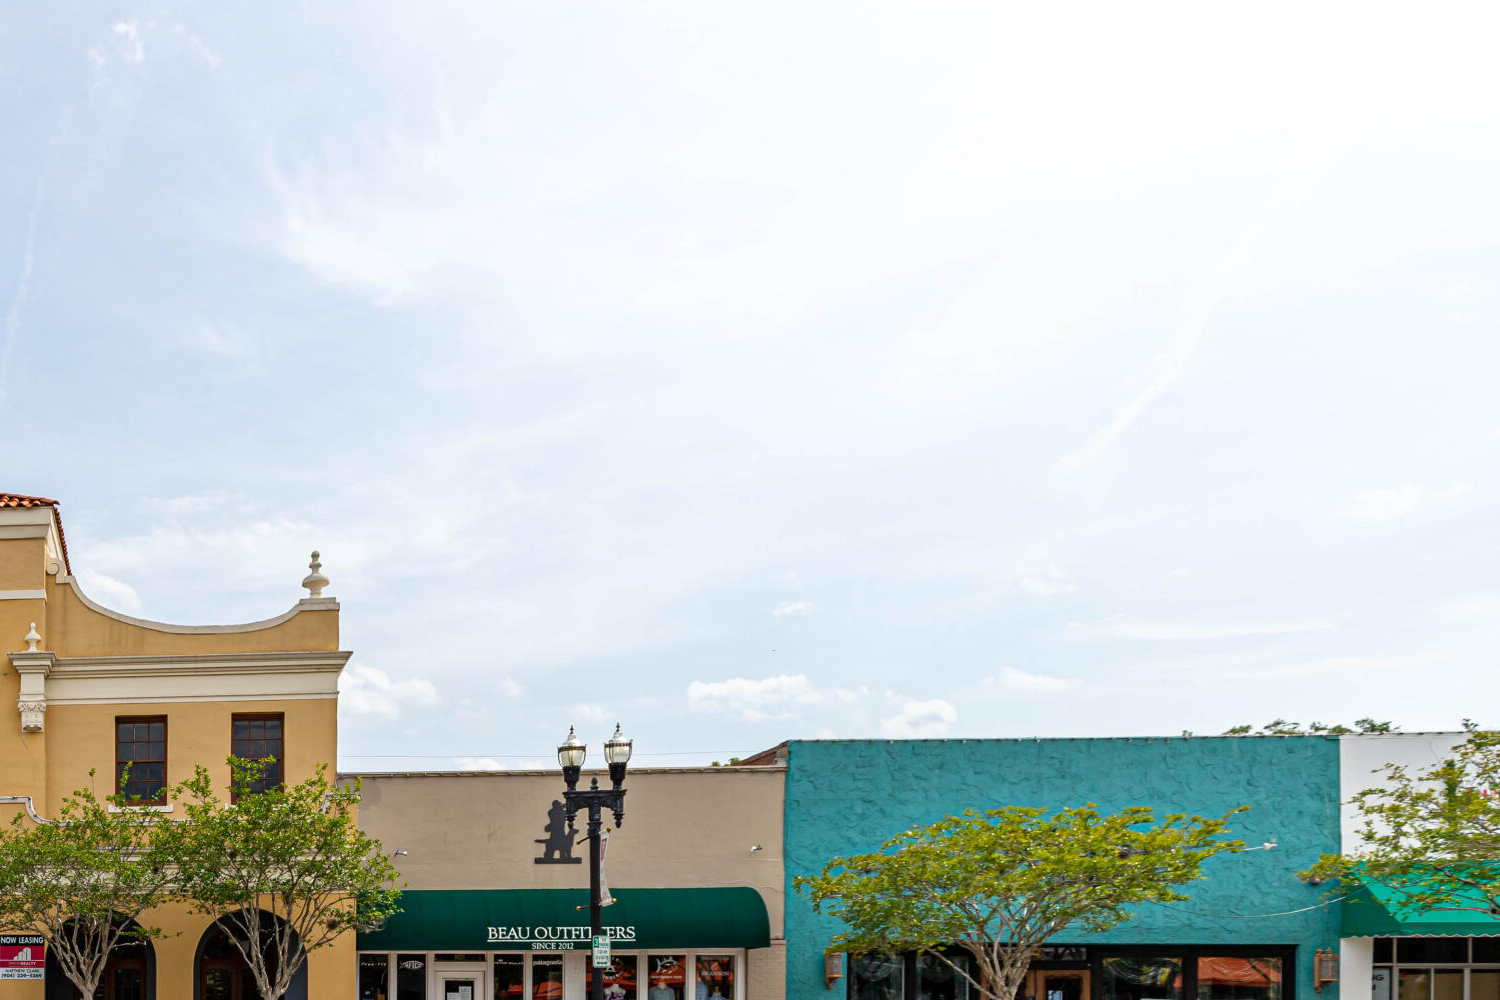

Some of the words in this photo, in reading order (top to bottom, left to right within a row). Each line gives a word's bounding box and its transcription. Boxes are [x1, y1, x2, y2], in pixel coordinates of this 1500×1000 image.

[487, 926, 530, 940] BEAU
[534, 926, 636, 940] OUTFITERS
[1, 936, 17, 944] NOW
[18, 936, 44, 944] LEASING
[531, 942, 556, 950] SINCE
[558, 942, 574, 950] 2012
